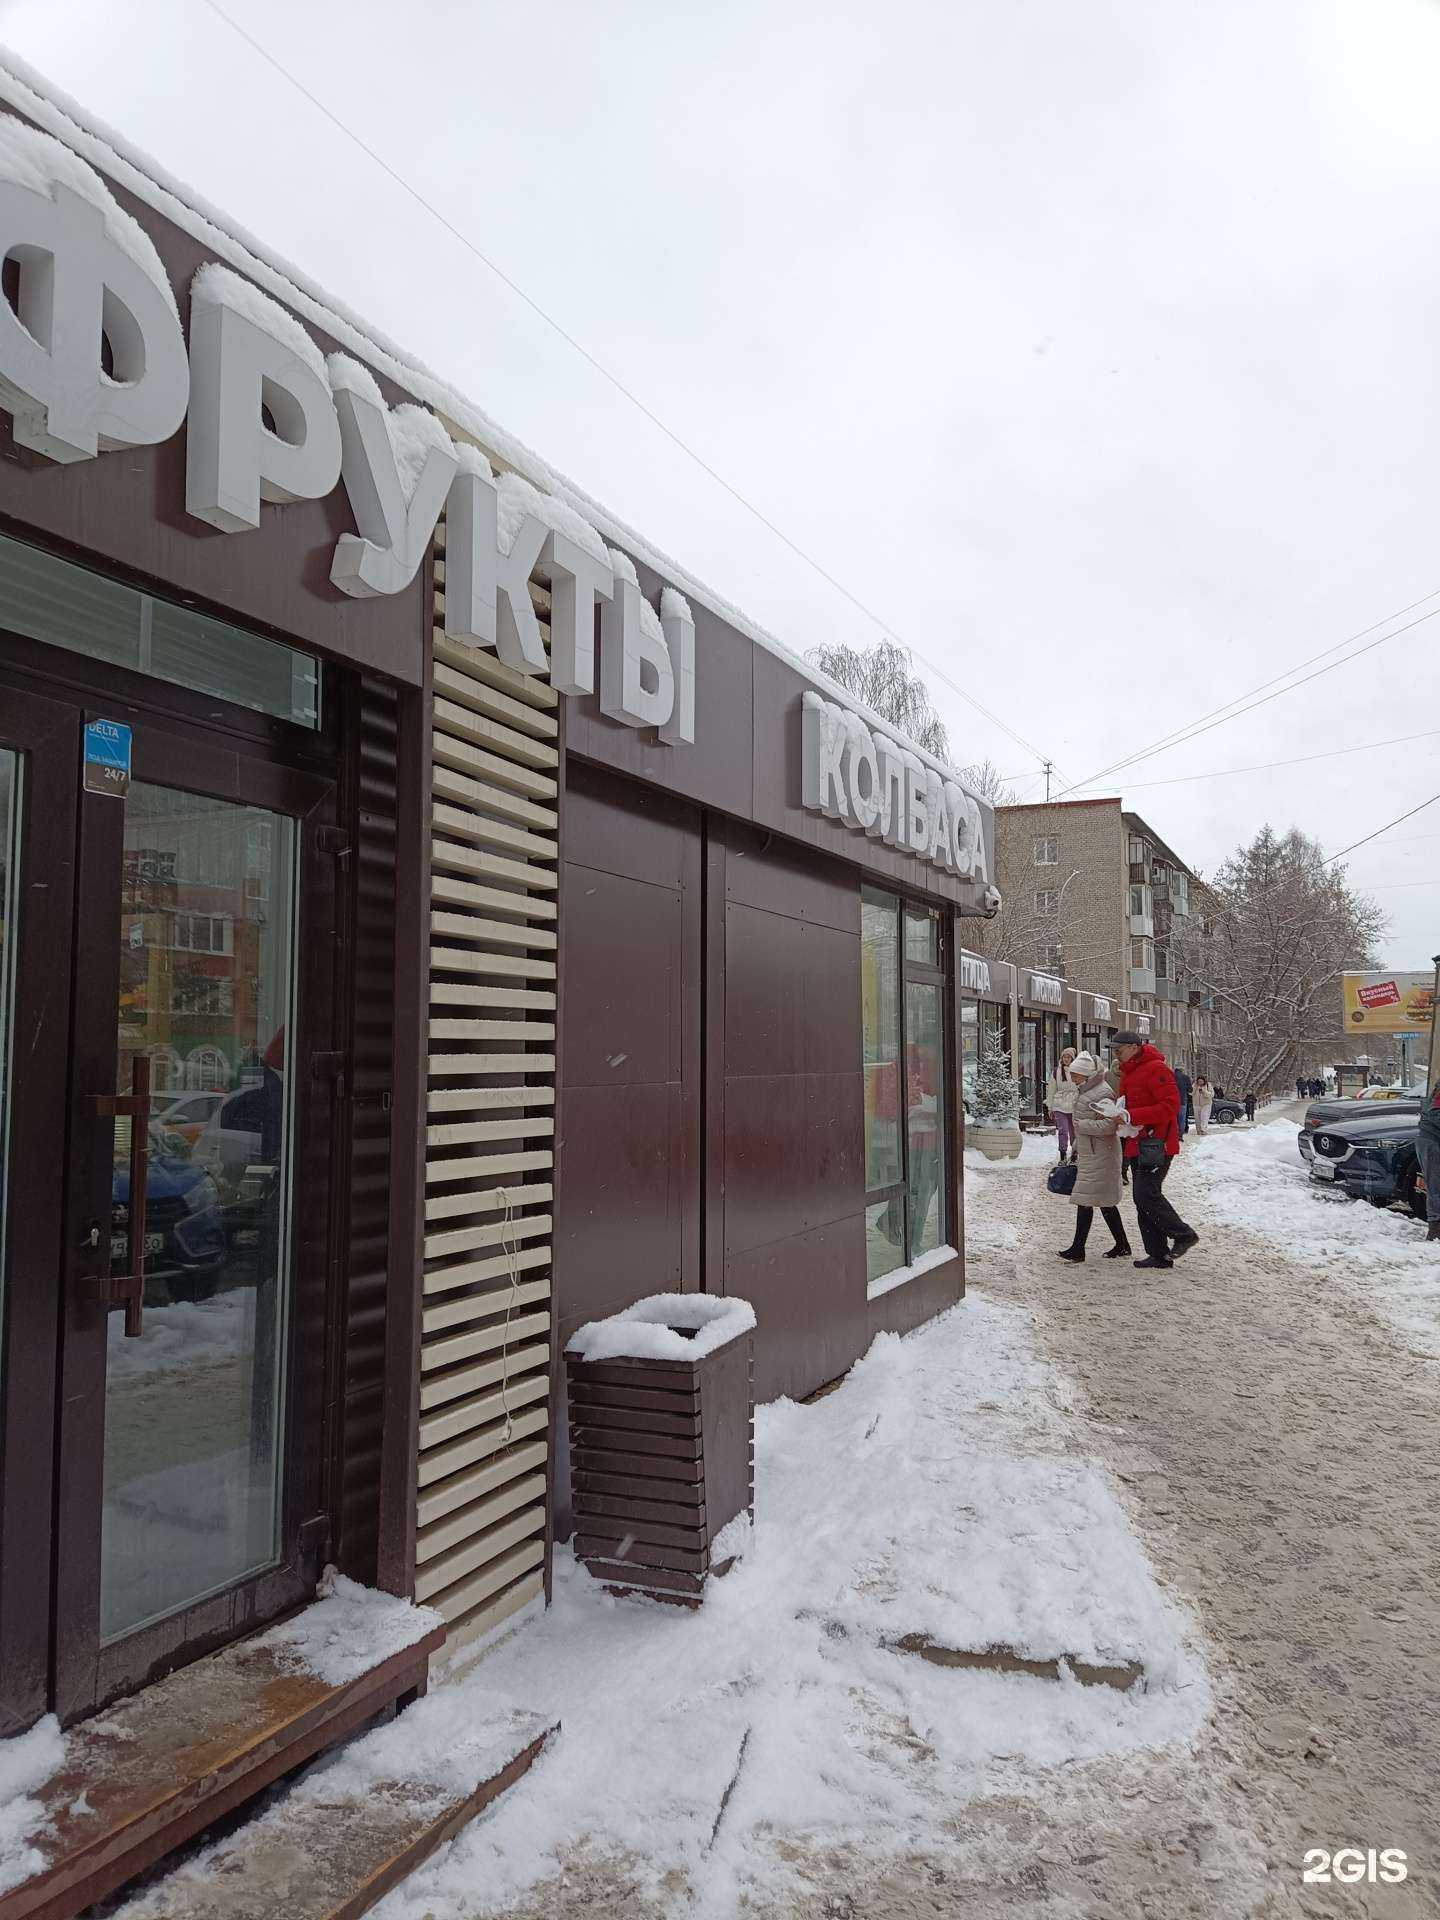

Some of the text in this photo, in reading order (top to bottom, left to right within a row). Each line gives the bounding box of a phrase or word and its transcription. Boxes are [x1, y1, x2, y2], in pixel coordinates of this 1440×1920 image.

[0, 176, 695, 746] ФРУКТЫ
[88, 722, 120, 739] DELTA
[104, 766, 128, 782] 24/7
[802, 702, 989, 885] КОЛБАСА
